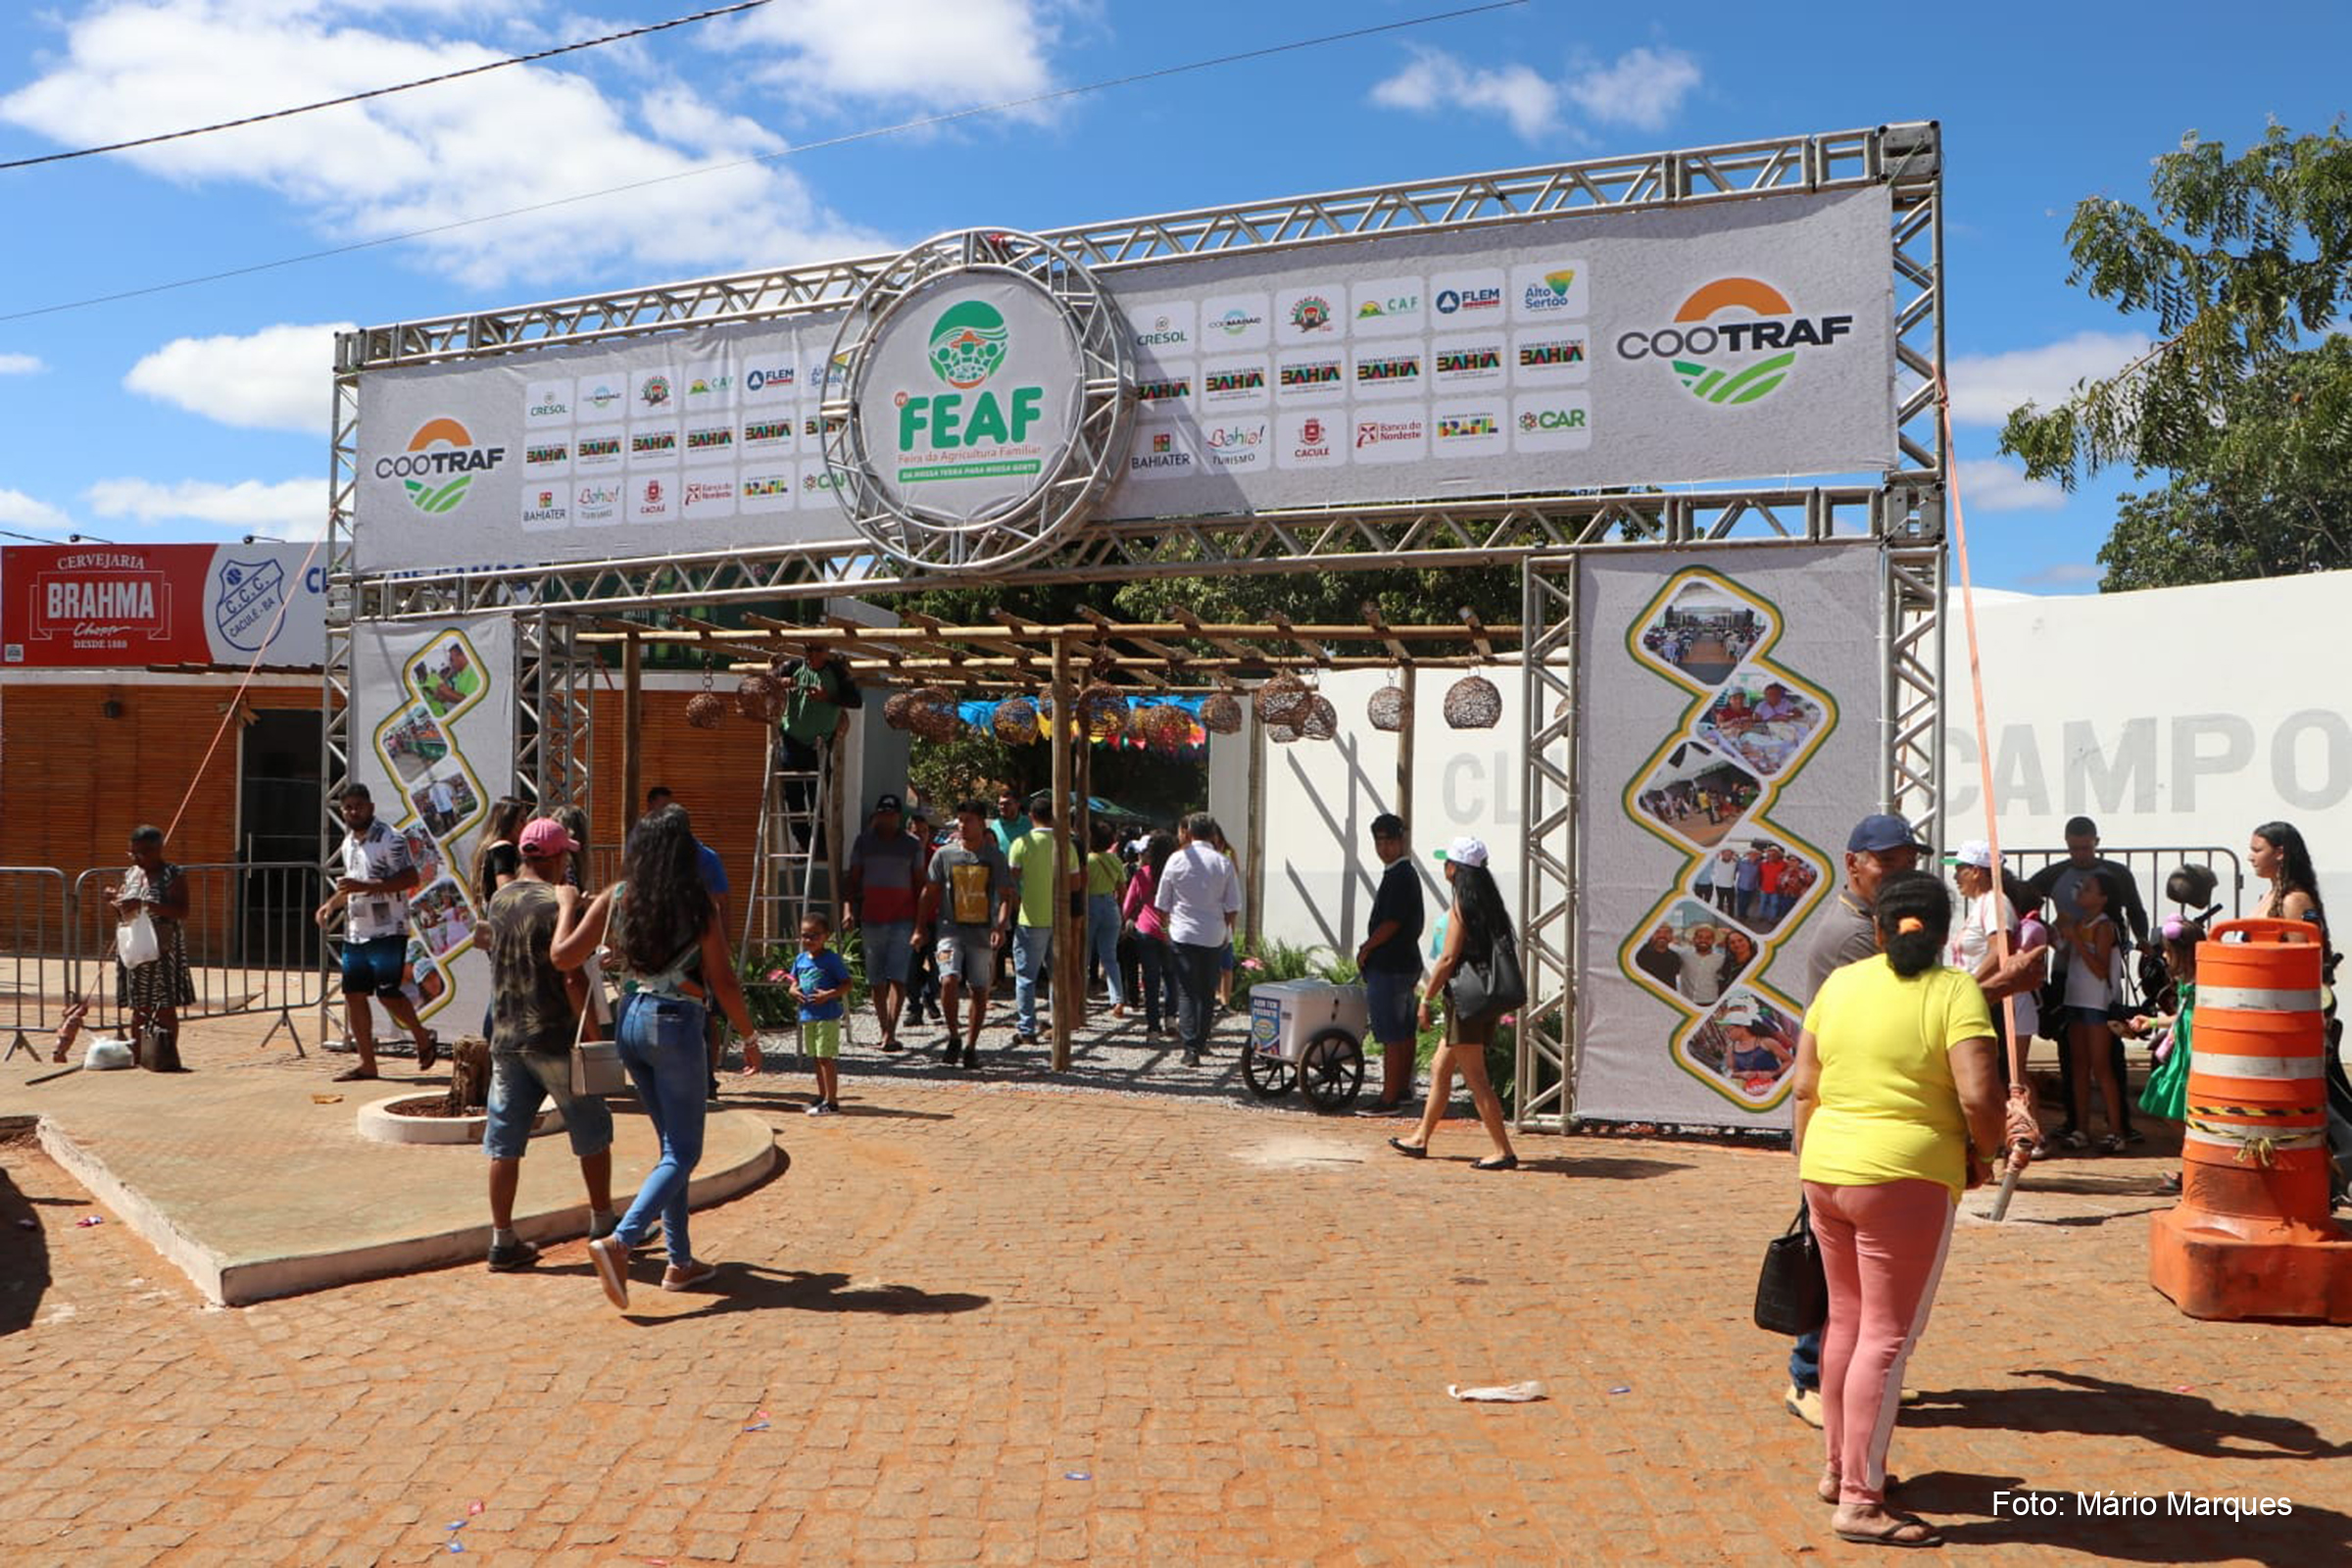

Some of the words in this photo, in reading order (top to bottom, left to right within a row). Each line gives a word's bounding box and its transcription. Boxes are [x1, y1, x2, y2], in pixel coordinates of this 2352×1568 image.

[1461, 288, 1500, 302] FLEM
[1525, 288, 1551, 299] Alto
[1525, 297, 1568, 310] Sertão
[1137, 331, 1188, 346] CRESOL
[1616, 316, 1852, 360] COOTRAF
[1437, 352, 1500, 372] BAHIA
[1520, 346, 1584, 366] BAHIA
[765, 368, 794, 380] FLEM
[1281, 367, 1341, 385] BAHIA
[1357, 361, 1419, 380] BAHIA
[1205, 372, 1264, 392] BAHIA
[530, 404, 567, 416] CRESOL
[899, 387, 1043, 451] FEAF
[1380, 422, 1407, 431] Banco
[1408, 420, 1421, 430] do
[1539, 409, 1586, 429] CAR
[688, 431, 733, 449] BAHIA
[745, 423, 792, 442] BAHIA
[1206, 425, 1264, 447] Bahia!
[1380, 430, 1422, 441] Nordeste
[578, 440, 621, 457] BAHIA
[632, 435, 676, 452] BAHIA
[526, 448, 568, 464] BAHIA
[898, 453, 923, 464] Feira
[925, 451, 938, 462] da
[940, 447, 997, 463] Agricultura
[999, 444, 1042, 457] Familiar
[1131, 454, 1191, 469] BAHIATER
[1212, 454, 1255, 466] TURISMO
[375, 448, 505, 479] COOTRAF
[523, 509, 565, 521] BAHIATER
[57, 553, 145, 569] CERVEJARIA
[47, 581, 155, 619] BRAHMA
[1923, 709, 2352, 817] CAMPO
